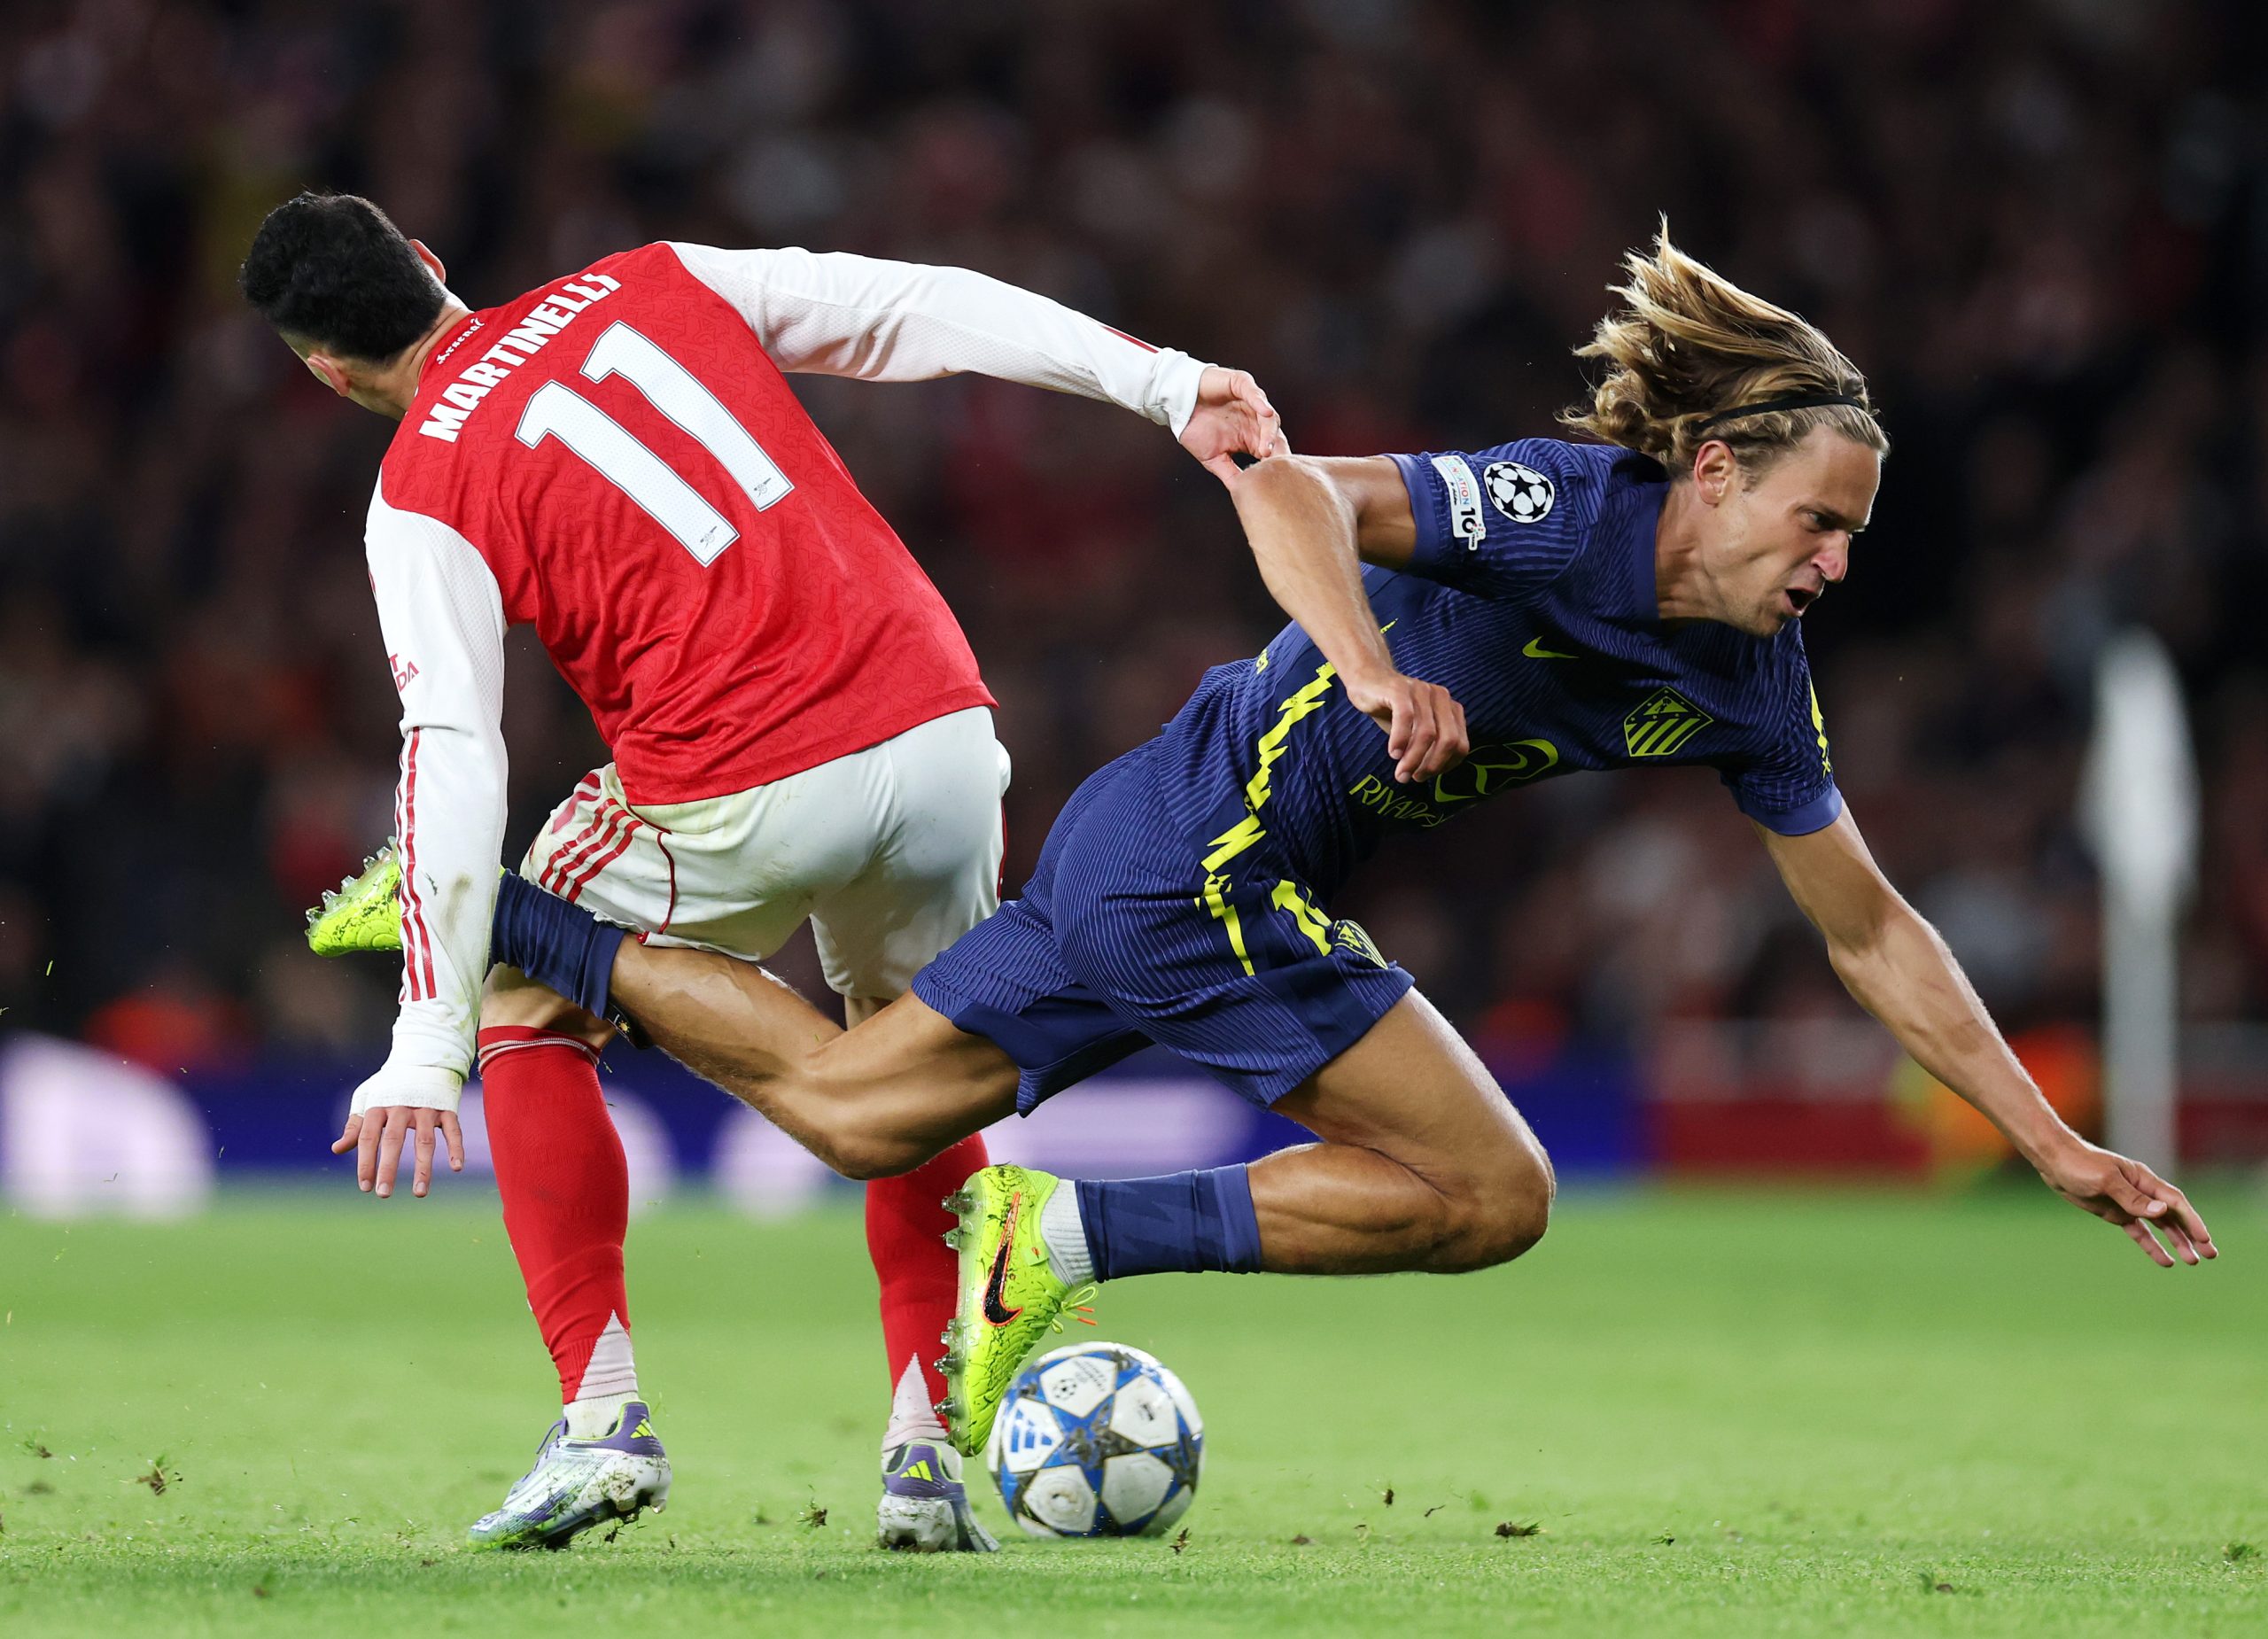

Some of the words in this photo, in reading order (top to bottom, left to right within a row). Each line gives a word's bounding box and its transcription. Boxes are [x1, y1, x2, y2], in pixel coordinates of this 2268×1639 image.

[418, 272, 621, 443] MARTINELLI
[436, 317, 485, 365] Arsenal
[515, 320, 795, 568] 11
[1460, 507, 1477, 533] 10
